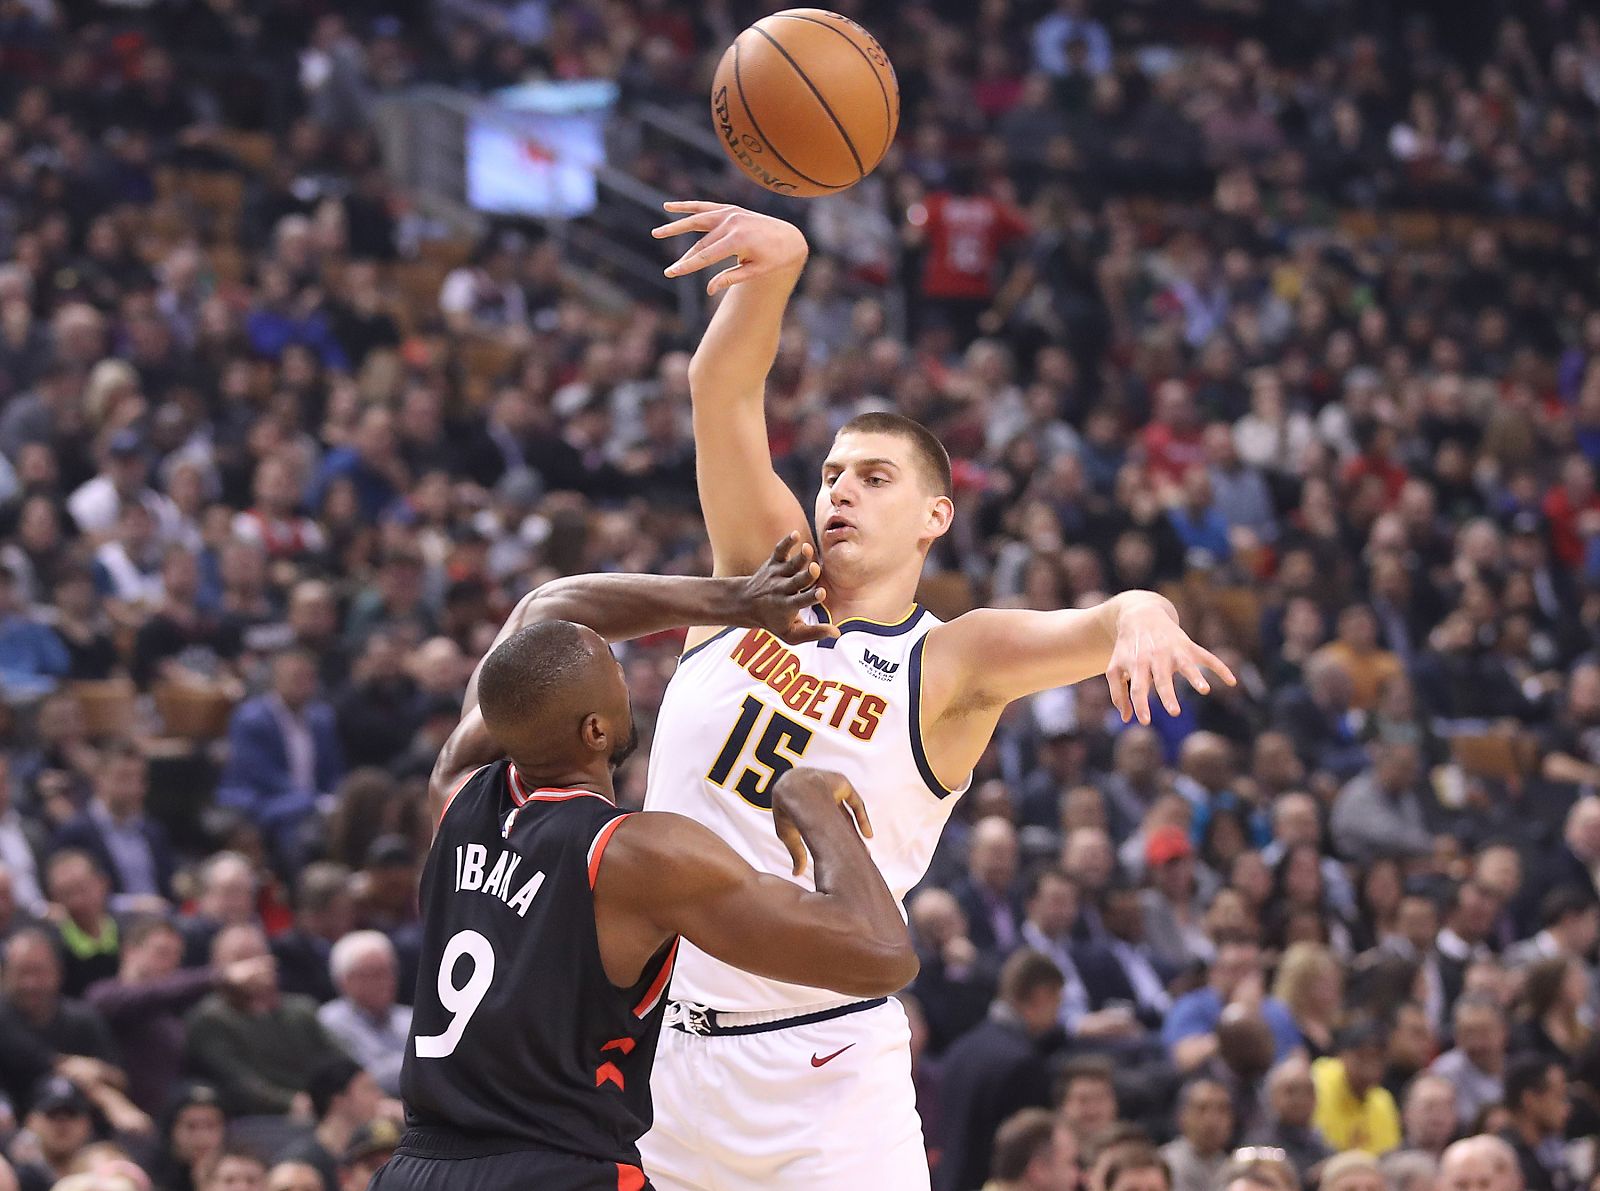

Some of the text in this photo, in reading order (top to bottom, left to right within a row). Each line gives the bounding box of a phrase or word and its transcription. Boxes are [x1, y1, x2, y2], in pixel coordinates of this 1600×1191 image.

[729, 628, 888, 742] NUGGETS
[863, 648, 900, 673] WU
[705, 692, 814, 811] 15
[455, 843, 546, 917] IBAKA
[415, 929, 495, 1058] 9
